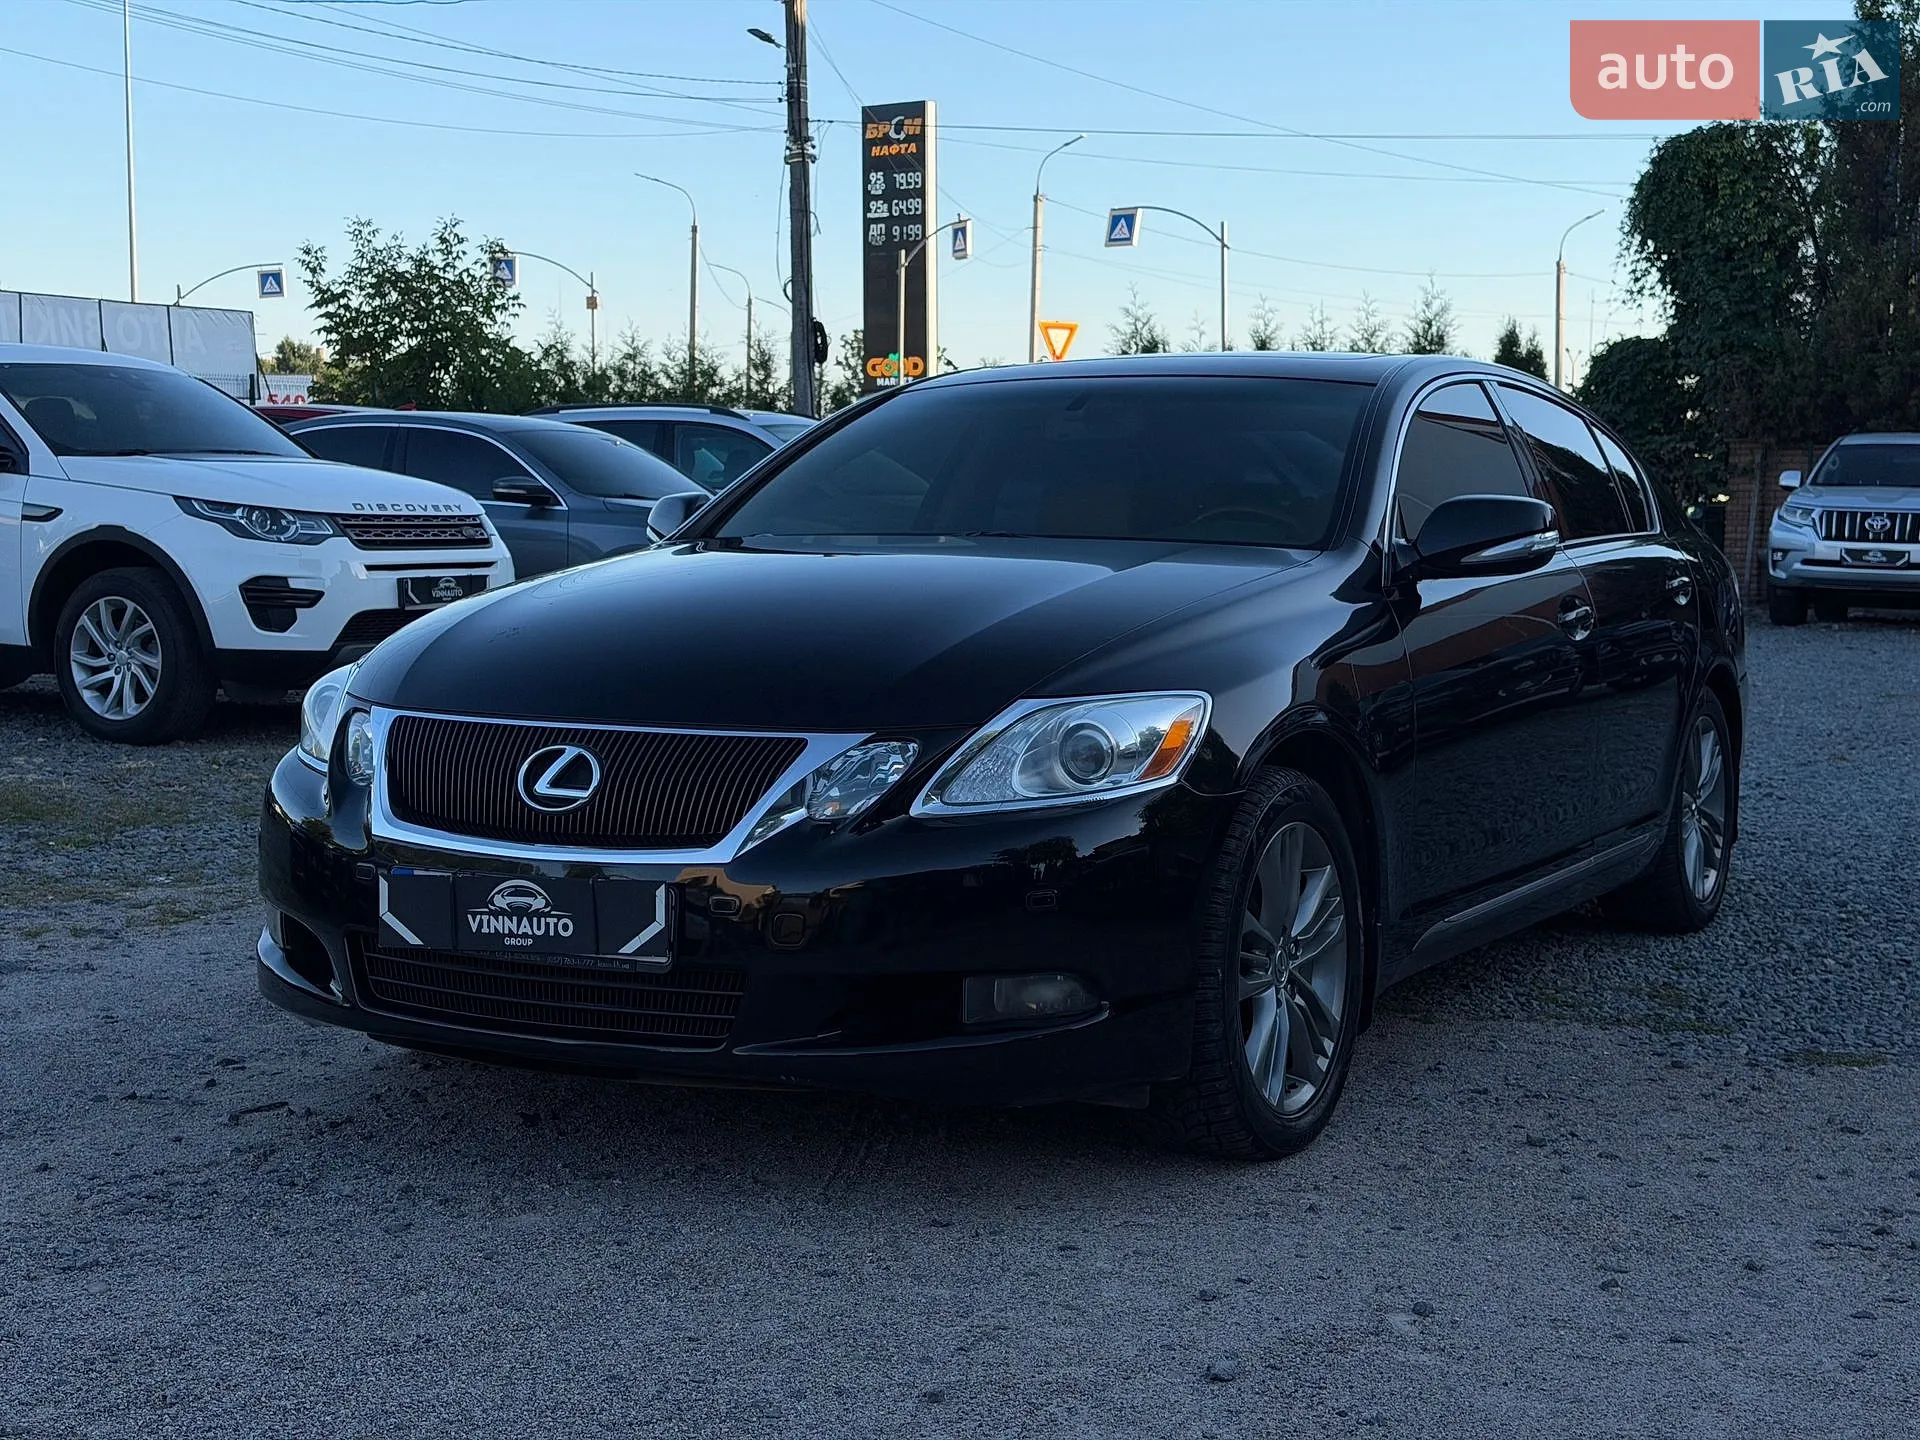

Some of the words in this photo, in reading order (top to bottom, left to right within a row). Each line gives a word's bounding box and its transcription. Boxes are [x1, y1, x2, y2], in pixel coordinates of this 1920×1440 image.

[871, 142, 917, 157] НАФТА
[869, 171, 884, 184] 95
[352, 502, 462, 512] DISCOVERY
[467, 914, 574, 937] VINNAUTO
[504, 937, 533, 946] GROUP
